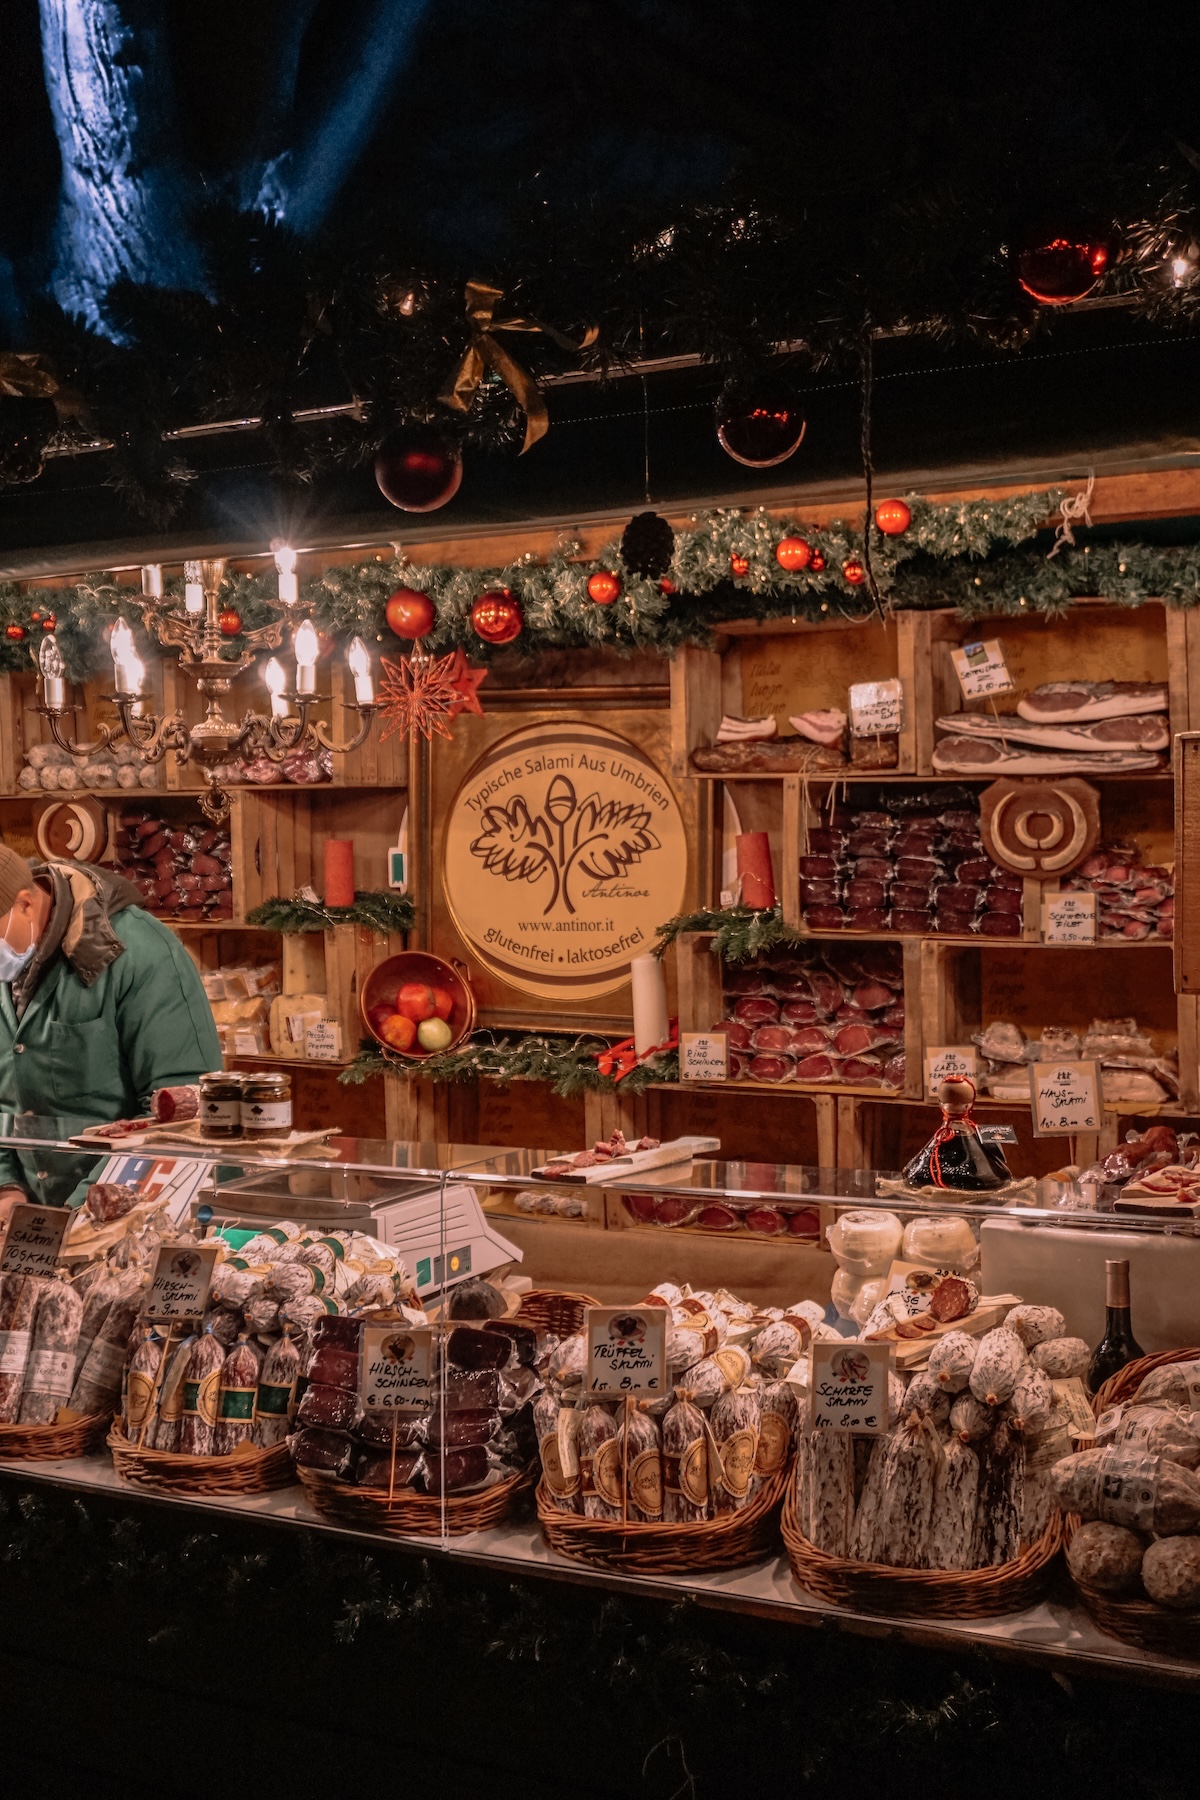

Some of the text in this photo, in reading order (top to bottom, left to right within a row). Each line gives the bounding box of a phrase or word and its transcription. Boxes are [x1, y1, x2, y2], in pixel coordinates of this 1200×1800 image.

[464, 754, 670, 813] Typische Salami Aus Umbrien
[518, 918, 615, 932] www.antinor.it
[483, 927, 645, 964] glutenfrei laktosefrei
[1039, 1088, 1074, 1099] HAUS-
[1084, 1117, 1095, 1126] €
[6, 1245, 60, 1267] TOSKANO
[375, 1378, 431, 1388] SCHINKEN
[648, 1377, 659, 1389] €
[815, 1382, 874, 1396] SCHARFE
[825, 1397, 868, 1407] SALAMI
[864, 1416, 878, 1428] €
